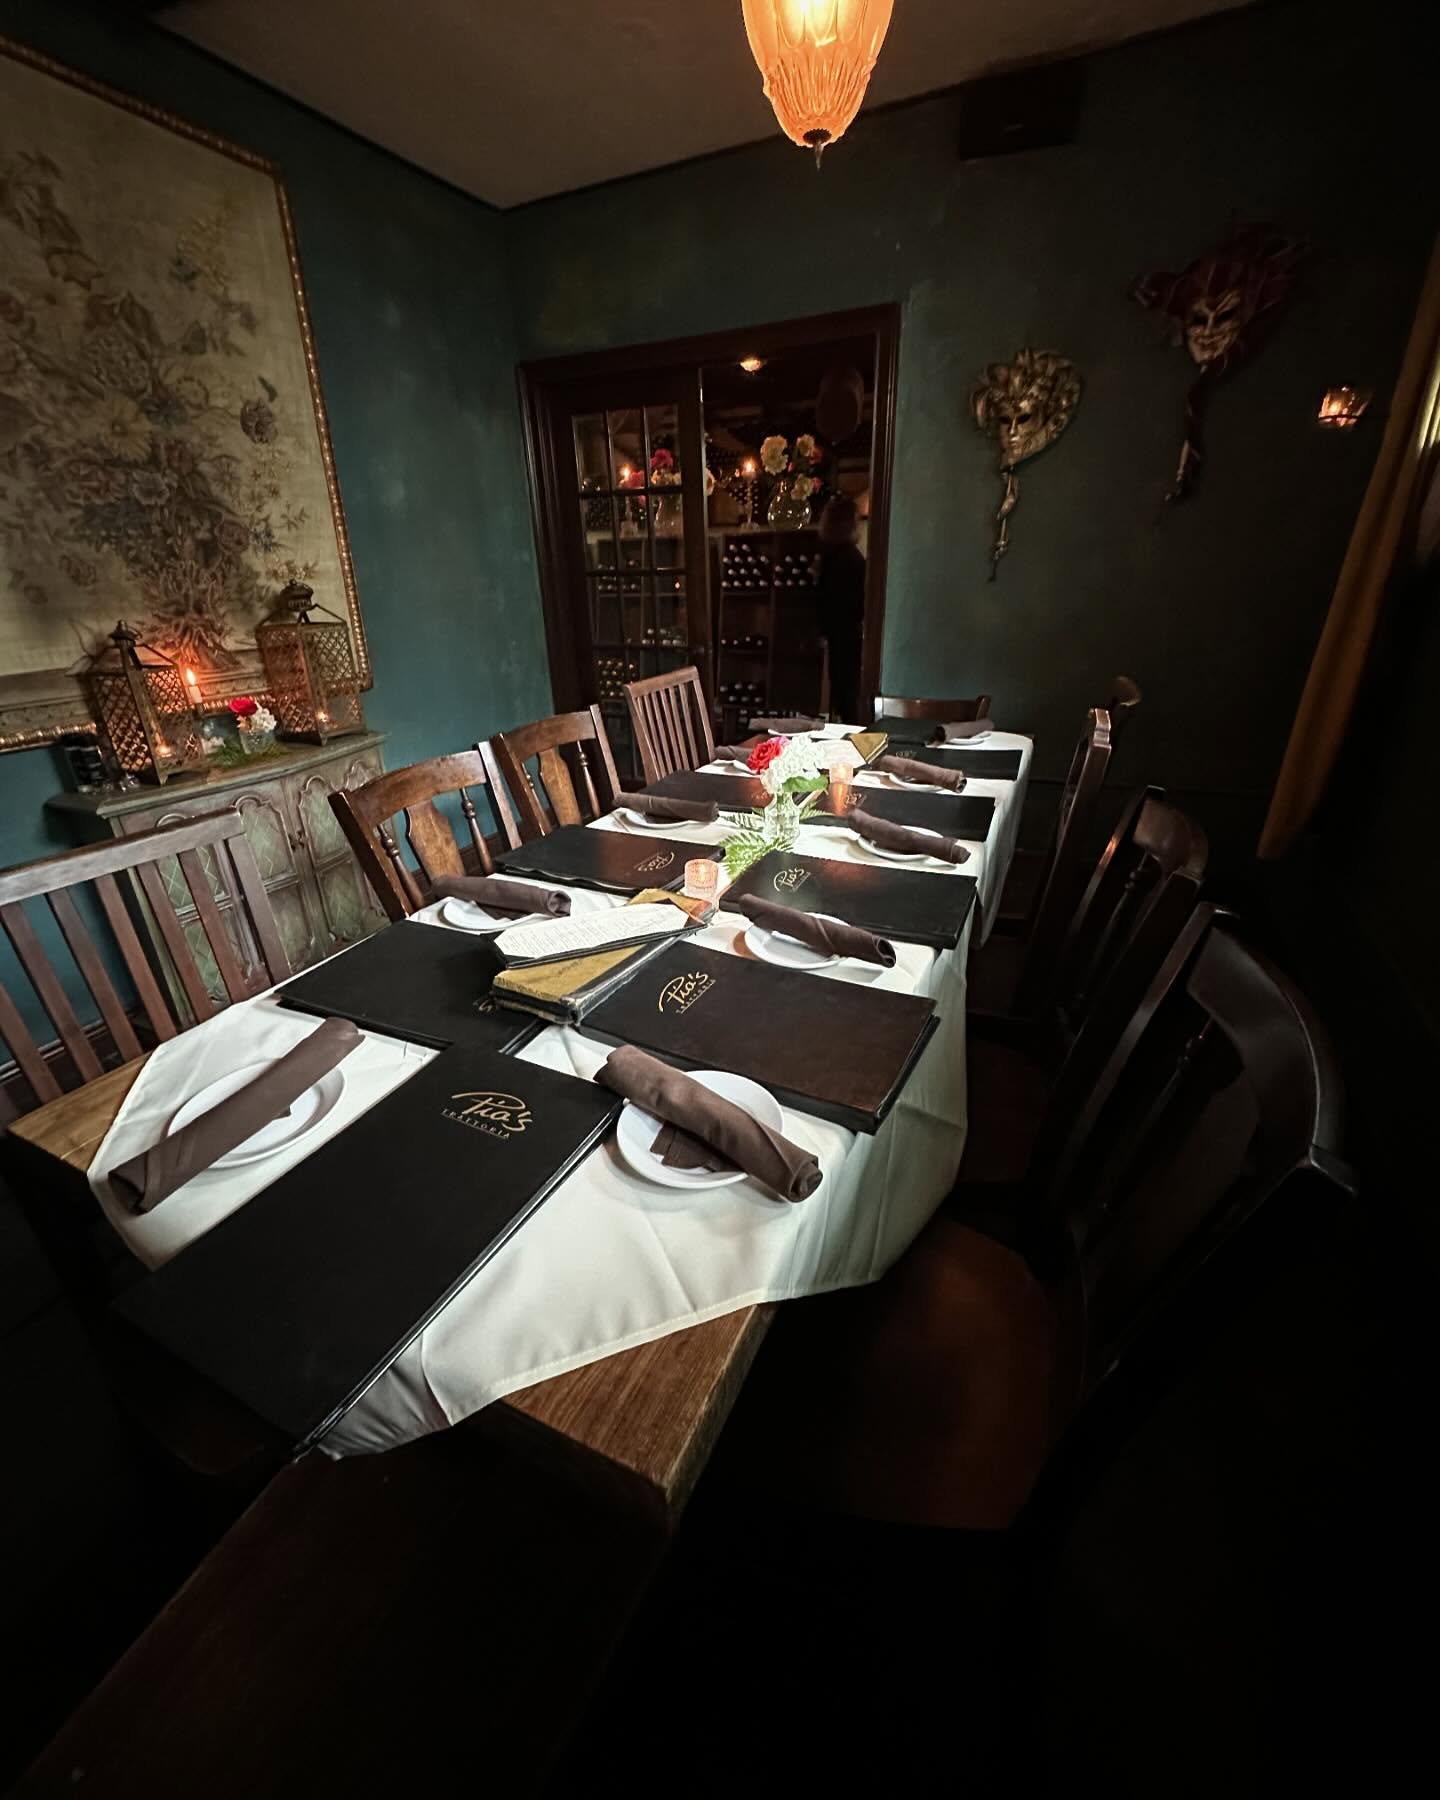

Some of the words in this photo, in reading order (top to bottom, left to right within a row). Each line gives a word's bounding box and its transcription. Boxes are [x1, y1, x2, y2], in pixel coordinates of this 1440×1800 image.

[773, 866, 805, 892] Pia's
[658, 971, 709, 1013] Pia's
[441, 1108, 511, 1140] TRATTORIA
[451, 1091, 533, 1132] Pia's
